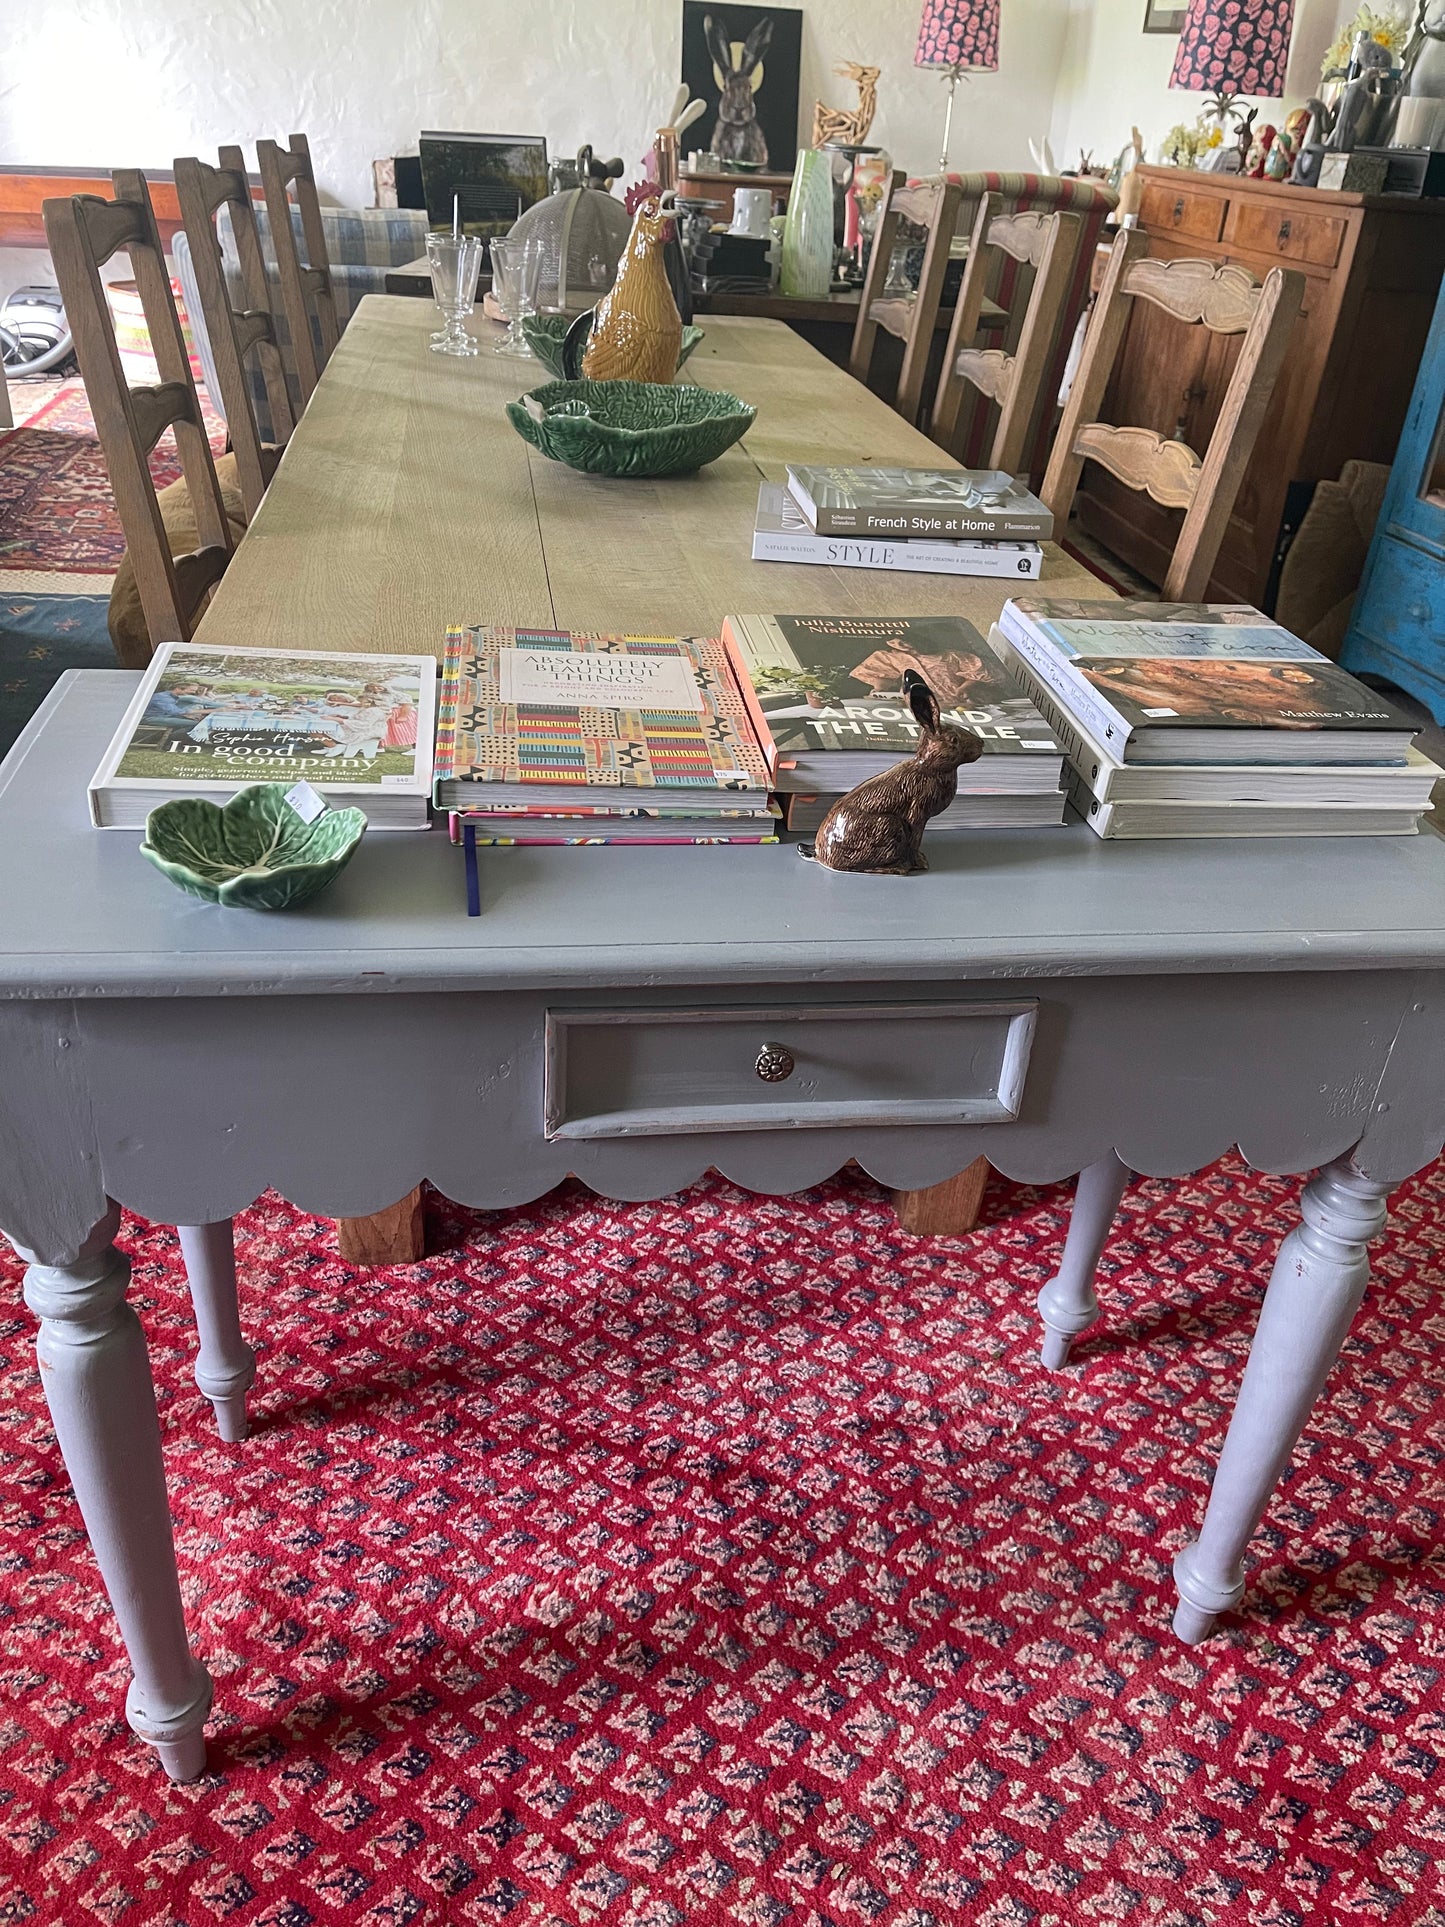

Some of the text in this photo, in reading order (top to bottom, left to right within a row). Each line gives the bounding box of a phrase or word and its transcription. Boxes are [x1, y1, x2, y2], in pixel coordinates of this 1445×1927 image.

[867, 516, 995, 531] French Style at Home
[1004, 522, 1041, 531] Flammarion
[826, 543, 895, 565] STYLE
[794, 619, 834, 627] Julia
[808, 626, 904, 635] Nishimura
[525, 655, 664, 669] ABSOLUTELY
[536, 664, 659, 676] BEAUTIFUL
[549, 673, 644, 683] THINGS
[1278, 709, 1389, 718] Matthew Evans
[806, 721, 1021, 739] THE TLE
[212, 732, 266, 745] Sophie
[166, 740, 295, 758] In good
[226, 756, 380, 771] company
